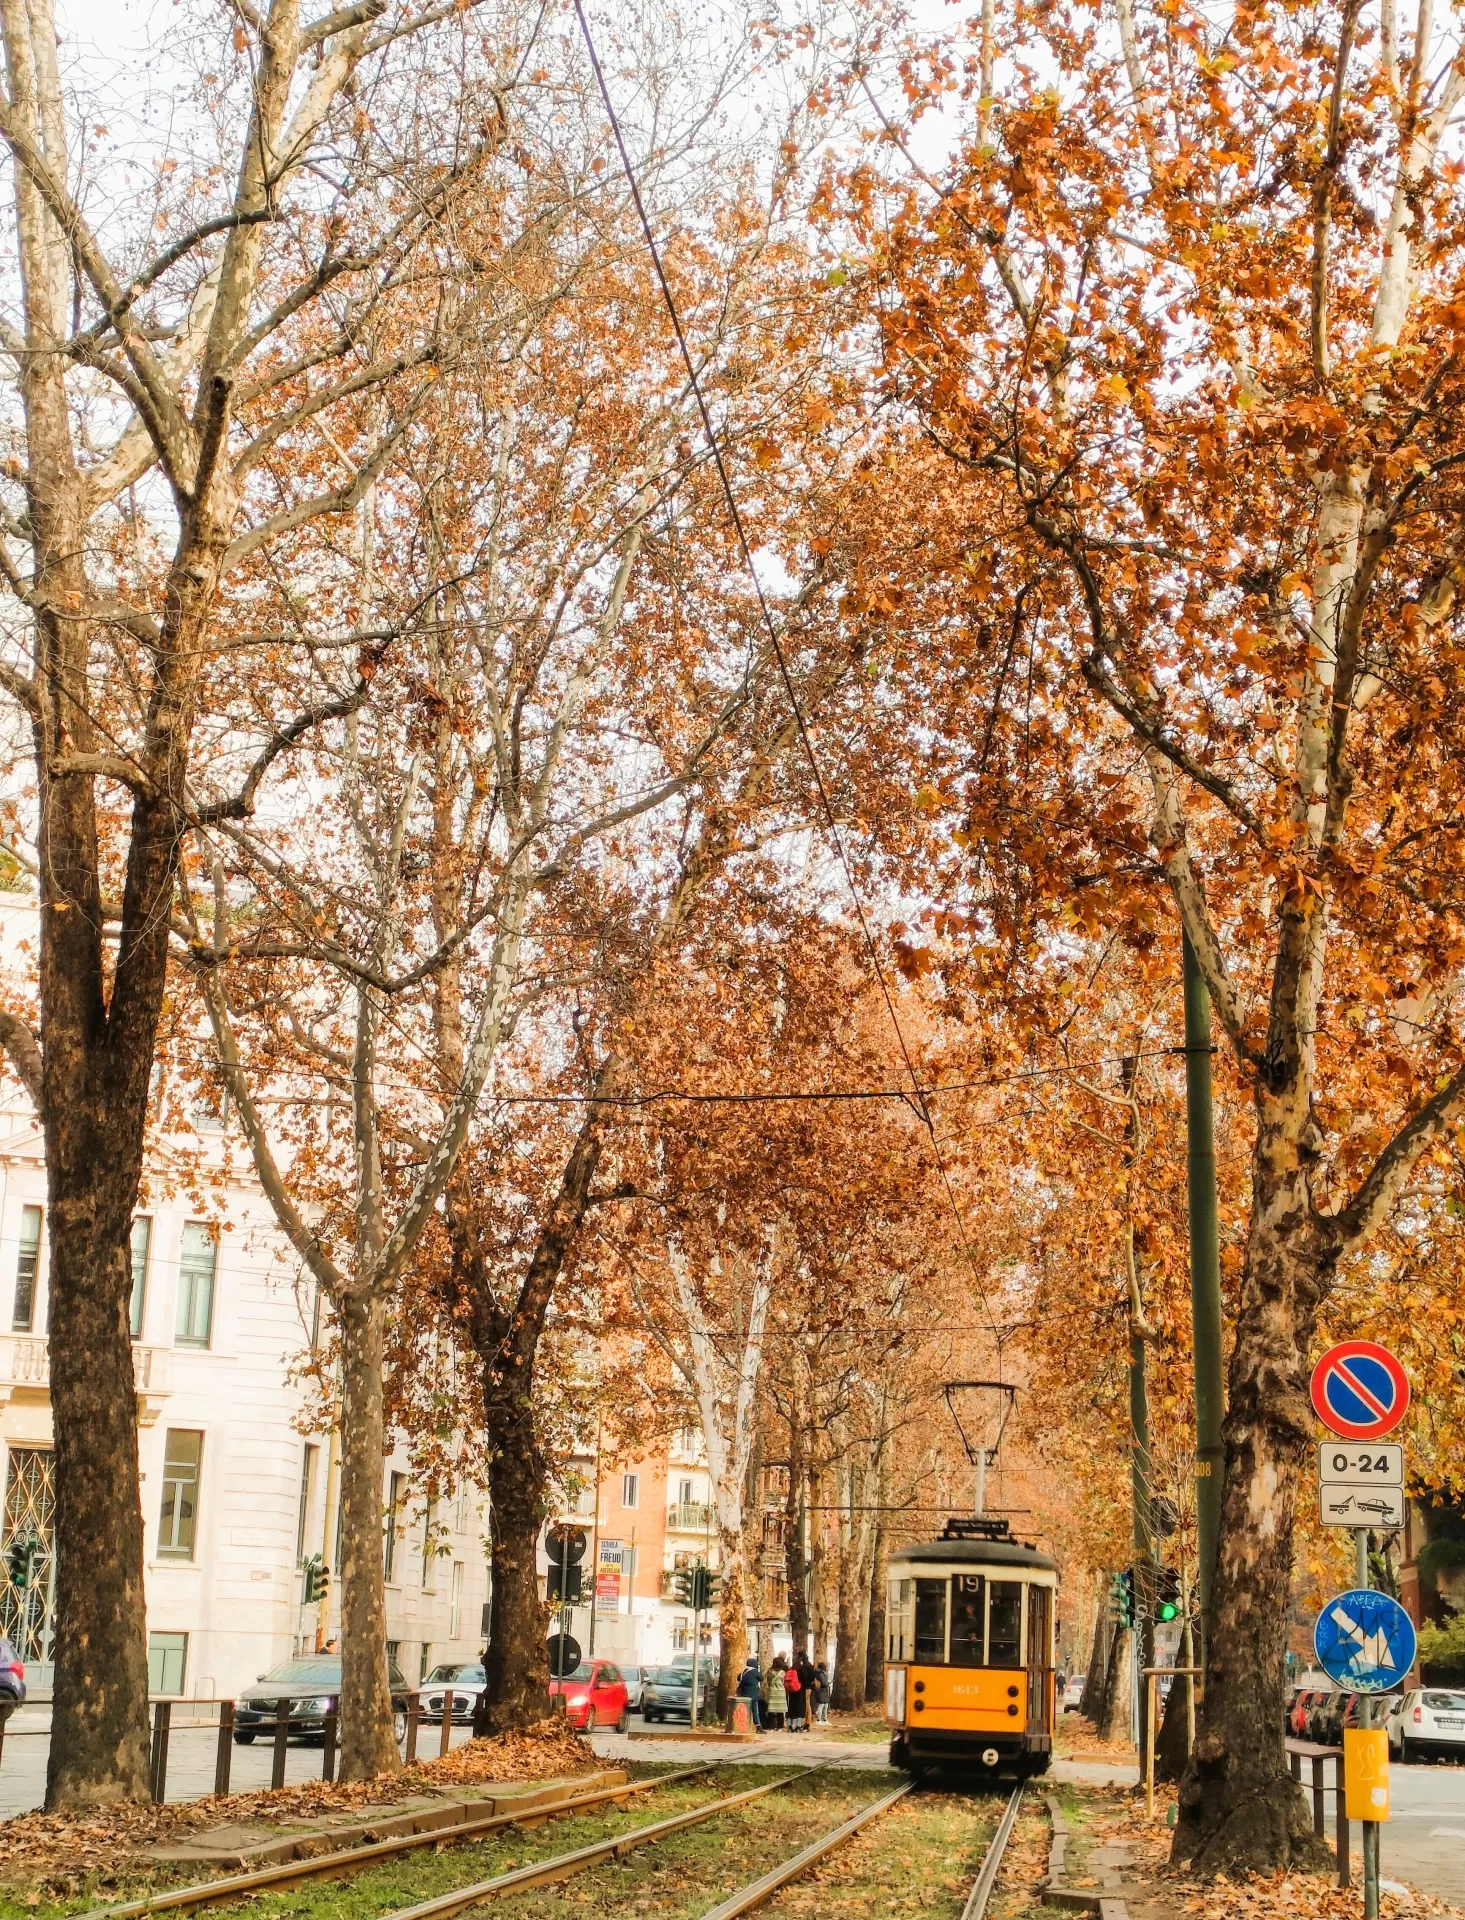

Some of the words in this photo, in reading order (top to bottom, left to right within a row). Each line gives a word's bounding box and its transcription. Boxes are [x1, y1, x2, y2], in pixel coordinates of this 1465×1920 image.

[1332, 1453, 1390, 1473] 0-24
[601, 1541, 618, 1549] SCUOLA
[600, 1552, 621, 1563] FREUD
[959, 1575, 979, 1592] 19
